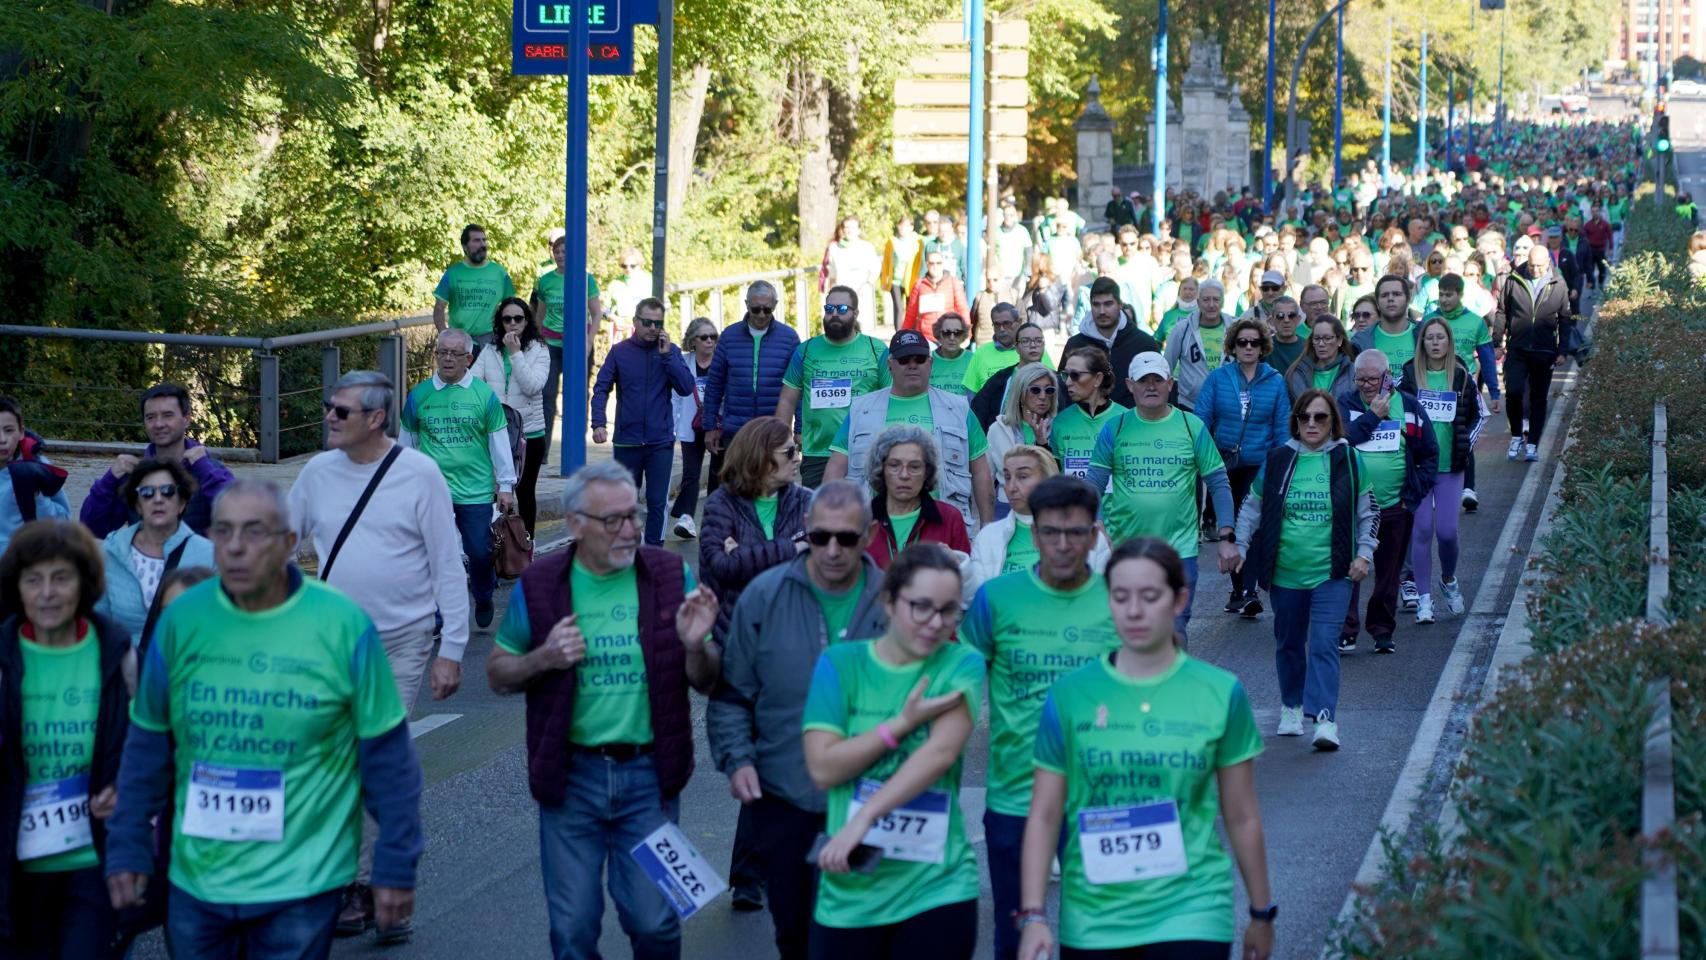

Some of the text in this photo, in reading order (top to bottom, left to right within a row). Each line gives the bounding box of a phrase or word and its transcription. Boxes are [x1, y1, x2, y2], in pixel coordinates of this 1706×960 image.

[815, 368, 868, 378] En marcha
[815, 389, 847, 399] 16369
[1422, 400, 1452, 411] 29376
[427, 415, 479, 425] En marcha
[1067, 447, 1080, 457] En
[1125, 455, 1188, 466] En marcha
[1126, 466, 1164, 476] contra
[1126, 478, 1136, 487] el
[1285, 501, 1328, 511] contra
[1301, 511, 1330, 522] cánc
[579, 651, 632, 668] ontra
[1013, 649, 1037, 666] En
[591, 668, 648, 687] cánce
[190, 681, 319, 710] En marcha
[187, 709, 264, 731] contra
[24, 739, 84, 758] ontra
[189, 730, 298, 755] el cáncer
[1087, 747, 1208, 771] En marcha
[198, 790, 272, 814] 31199
[875, 813, 928, 835] 577
[1099, 832, 1162, 856] 8579
[656, 838, 706, 897] 32762
